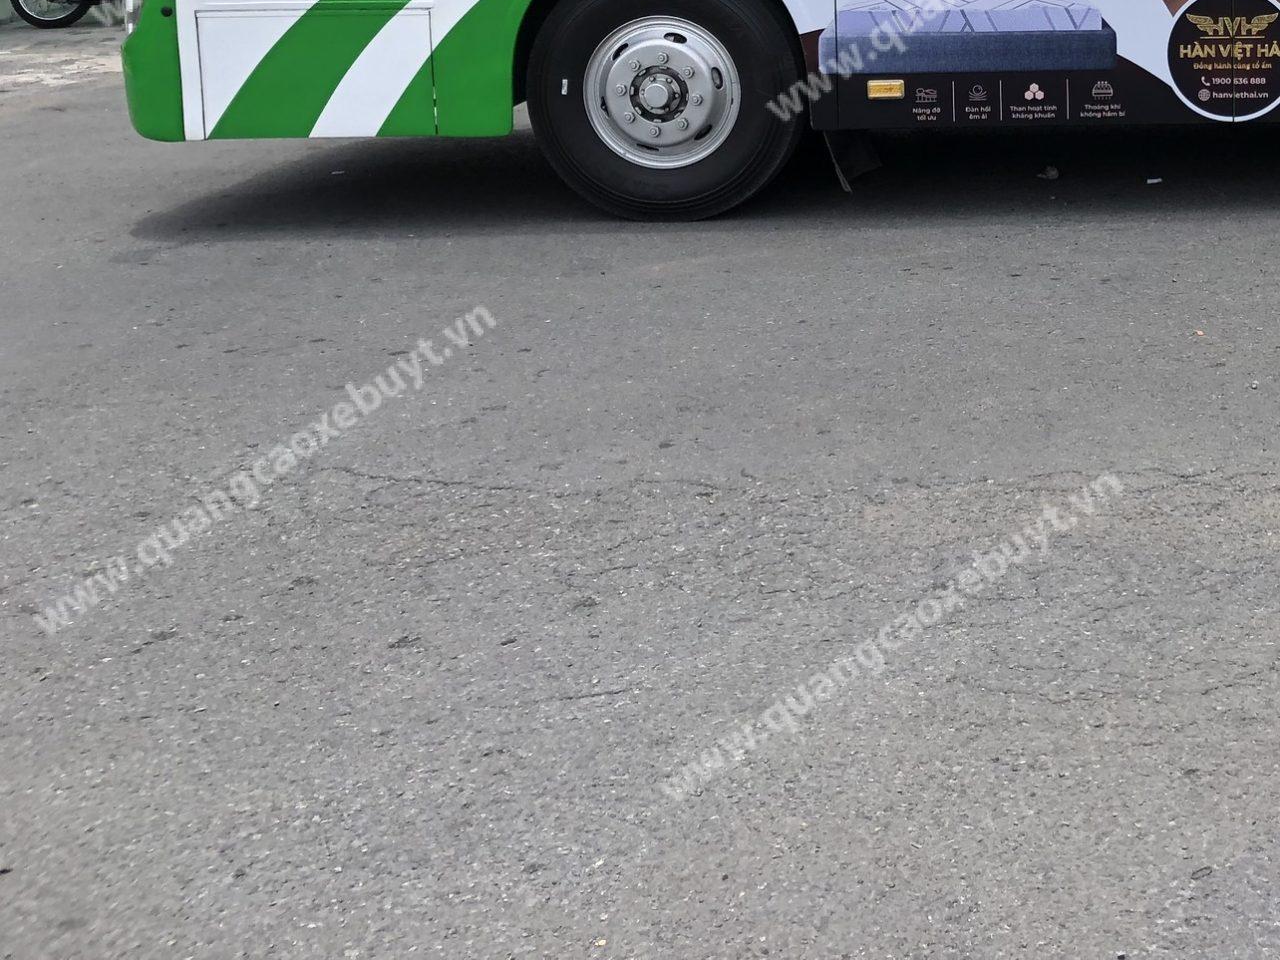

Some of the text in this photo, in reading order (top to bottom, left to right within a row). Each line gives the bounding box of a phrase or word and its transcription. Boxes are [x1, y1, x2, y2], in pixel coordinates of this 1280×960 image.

[1180, 41, 1215, 58] HÀN
[1219, 41, 1254, 60] VIỆT
[1212, 77, 1232, 85] 1900
